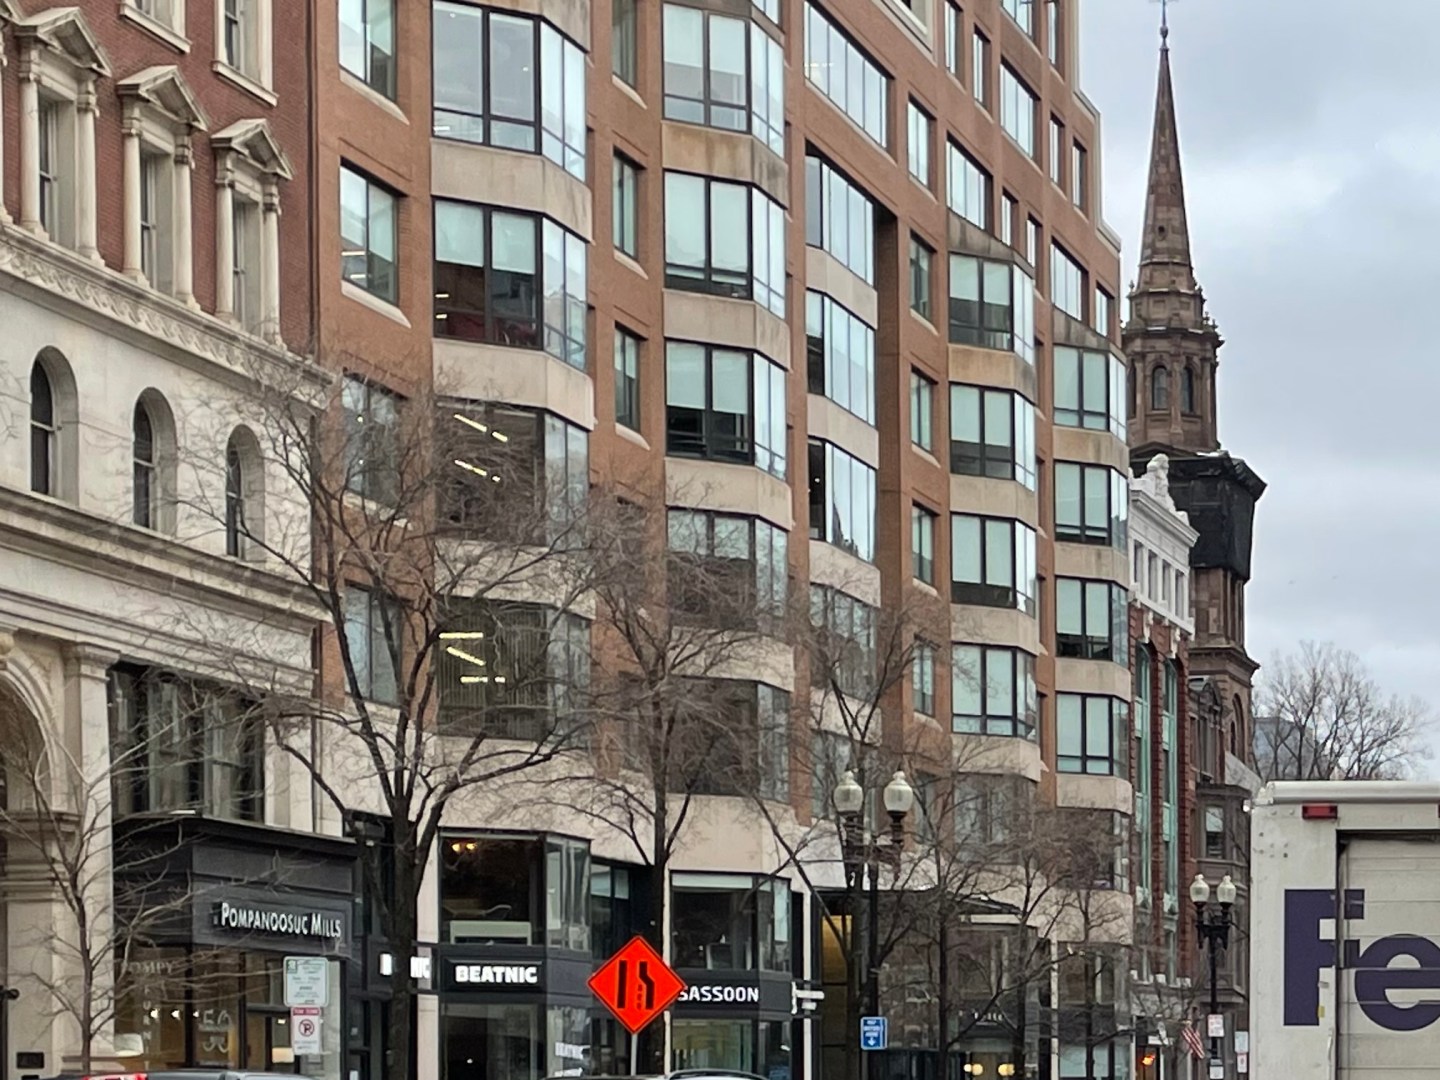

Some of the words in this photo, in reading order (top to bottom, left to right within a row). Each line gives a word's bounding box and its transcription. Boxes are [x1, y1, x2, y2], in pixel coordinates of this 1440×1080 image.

[311, 913, 341, 937] MILLS
[455, 965, 538, 984] BEATNIC
[678, 986, 759, 1002] SASSOON
